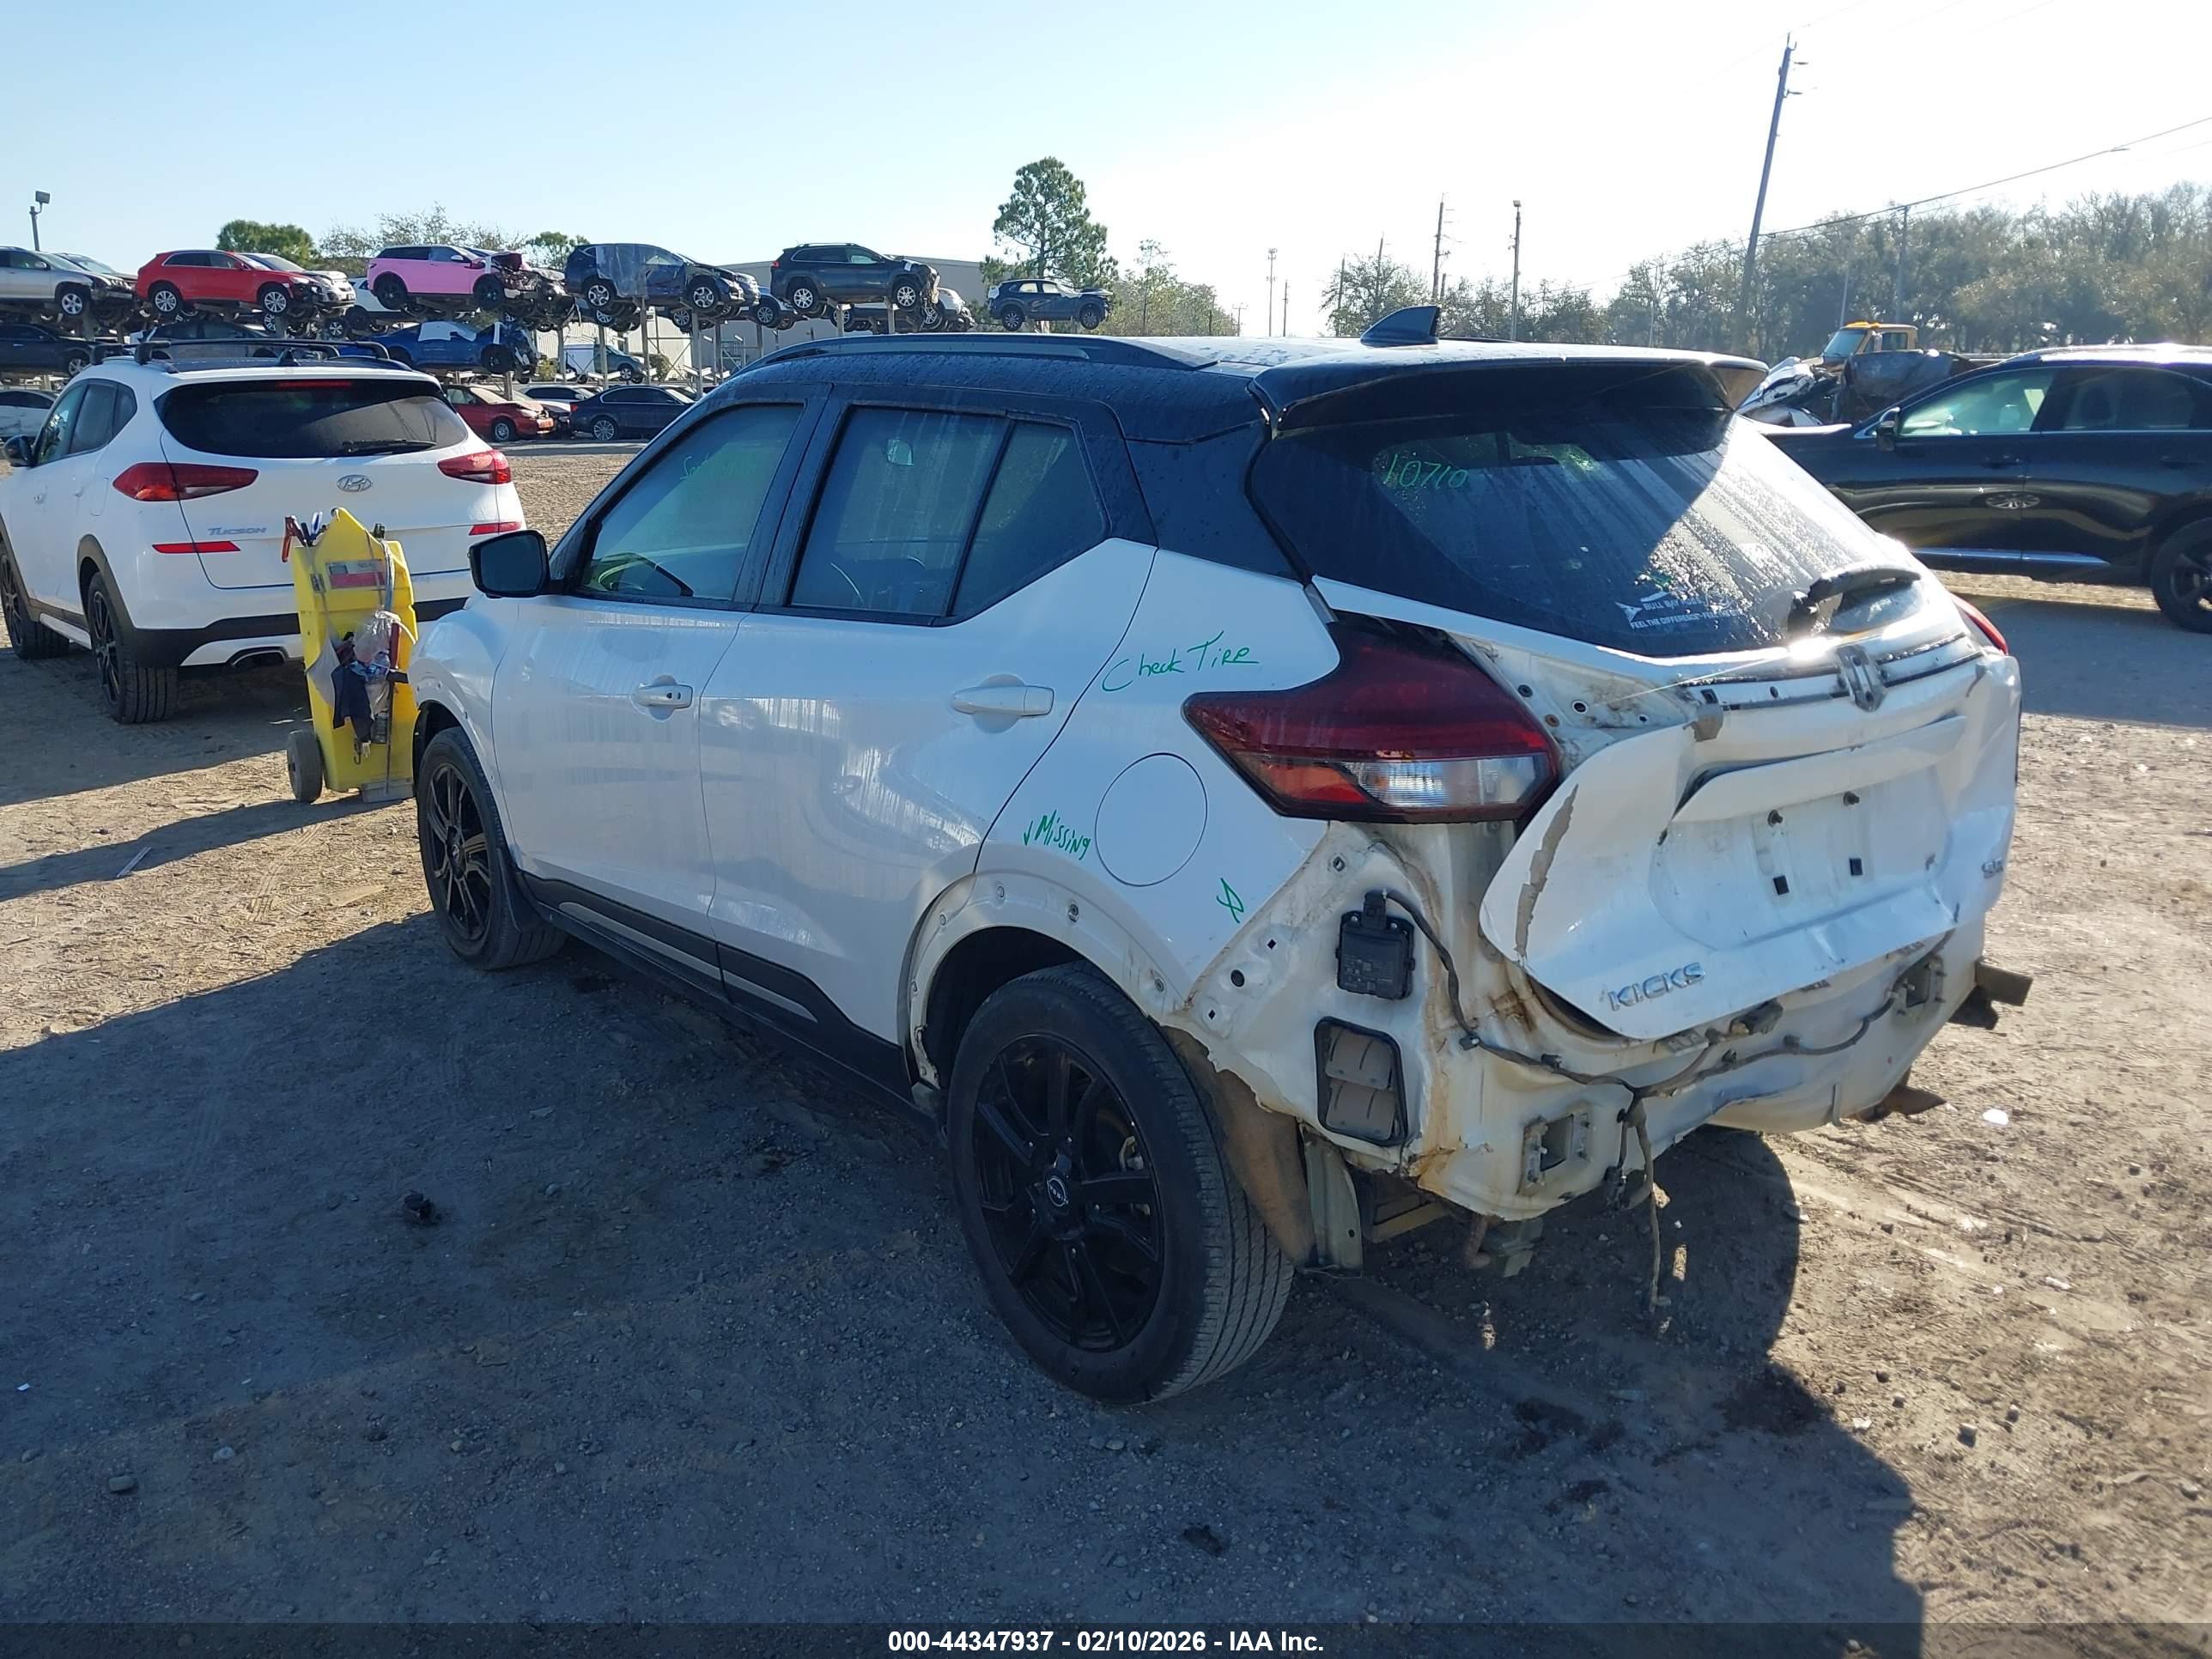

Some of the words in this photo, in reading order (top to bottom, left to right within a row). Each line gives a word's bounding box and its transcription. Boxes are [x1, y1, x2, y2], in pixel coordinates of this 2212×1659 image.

[1382, 453, 1468, 489] 10710
[1630, 620, 1649, 629] FEEL
[1648, 617, 1661, 627] THE
[1660, 613, 1700, 624] DIFFERENCE
[1643, 601, 1664, 611] BULL
[1664, 599, 1680, 610] BAY
[1102, 648, 1185, 692] Check
[1607, 962, 1706, 1012] KICKS
